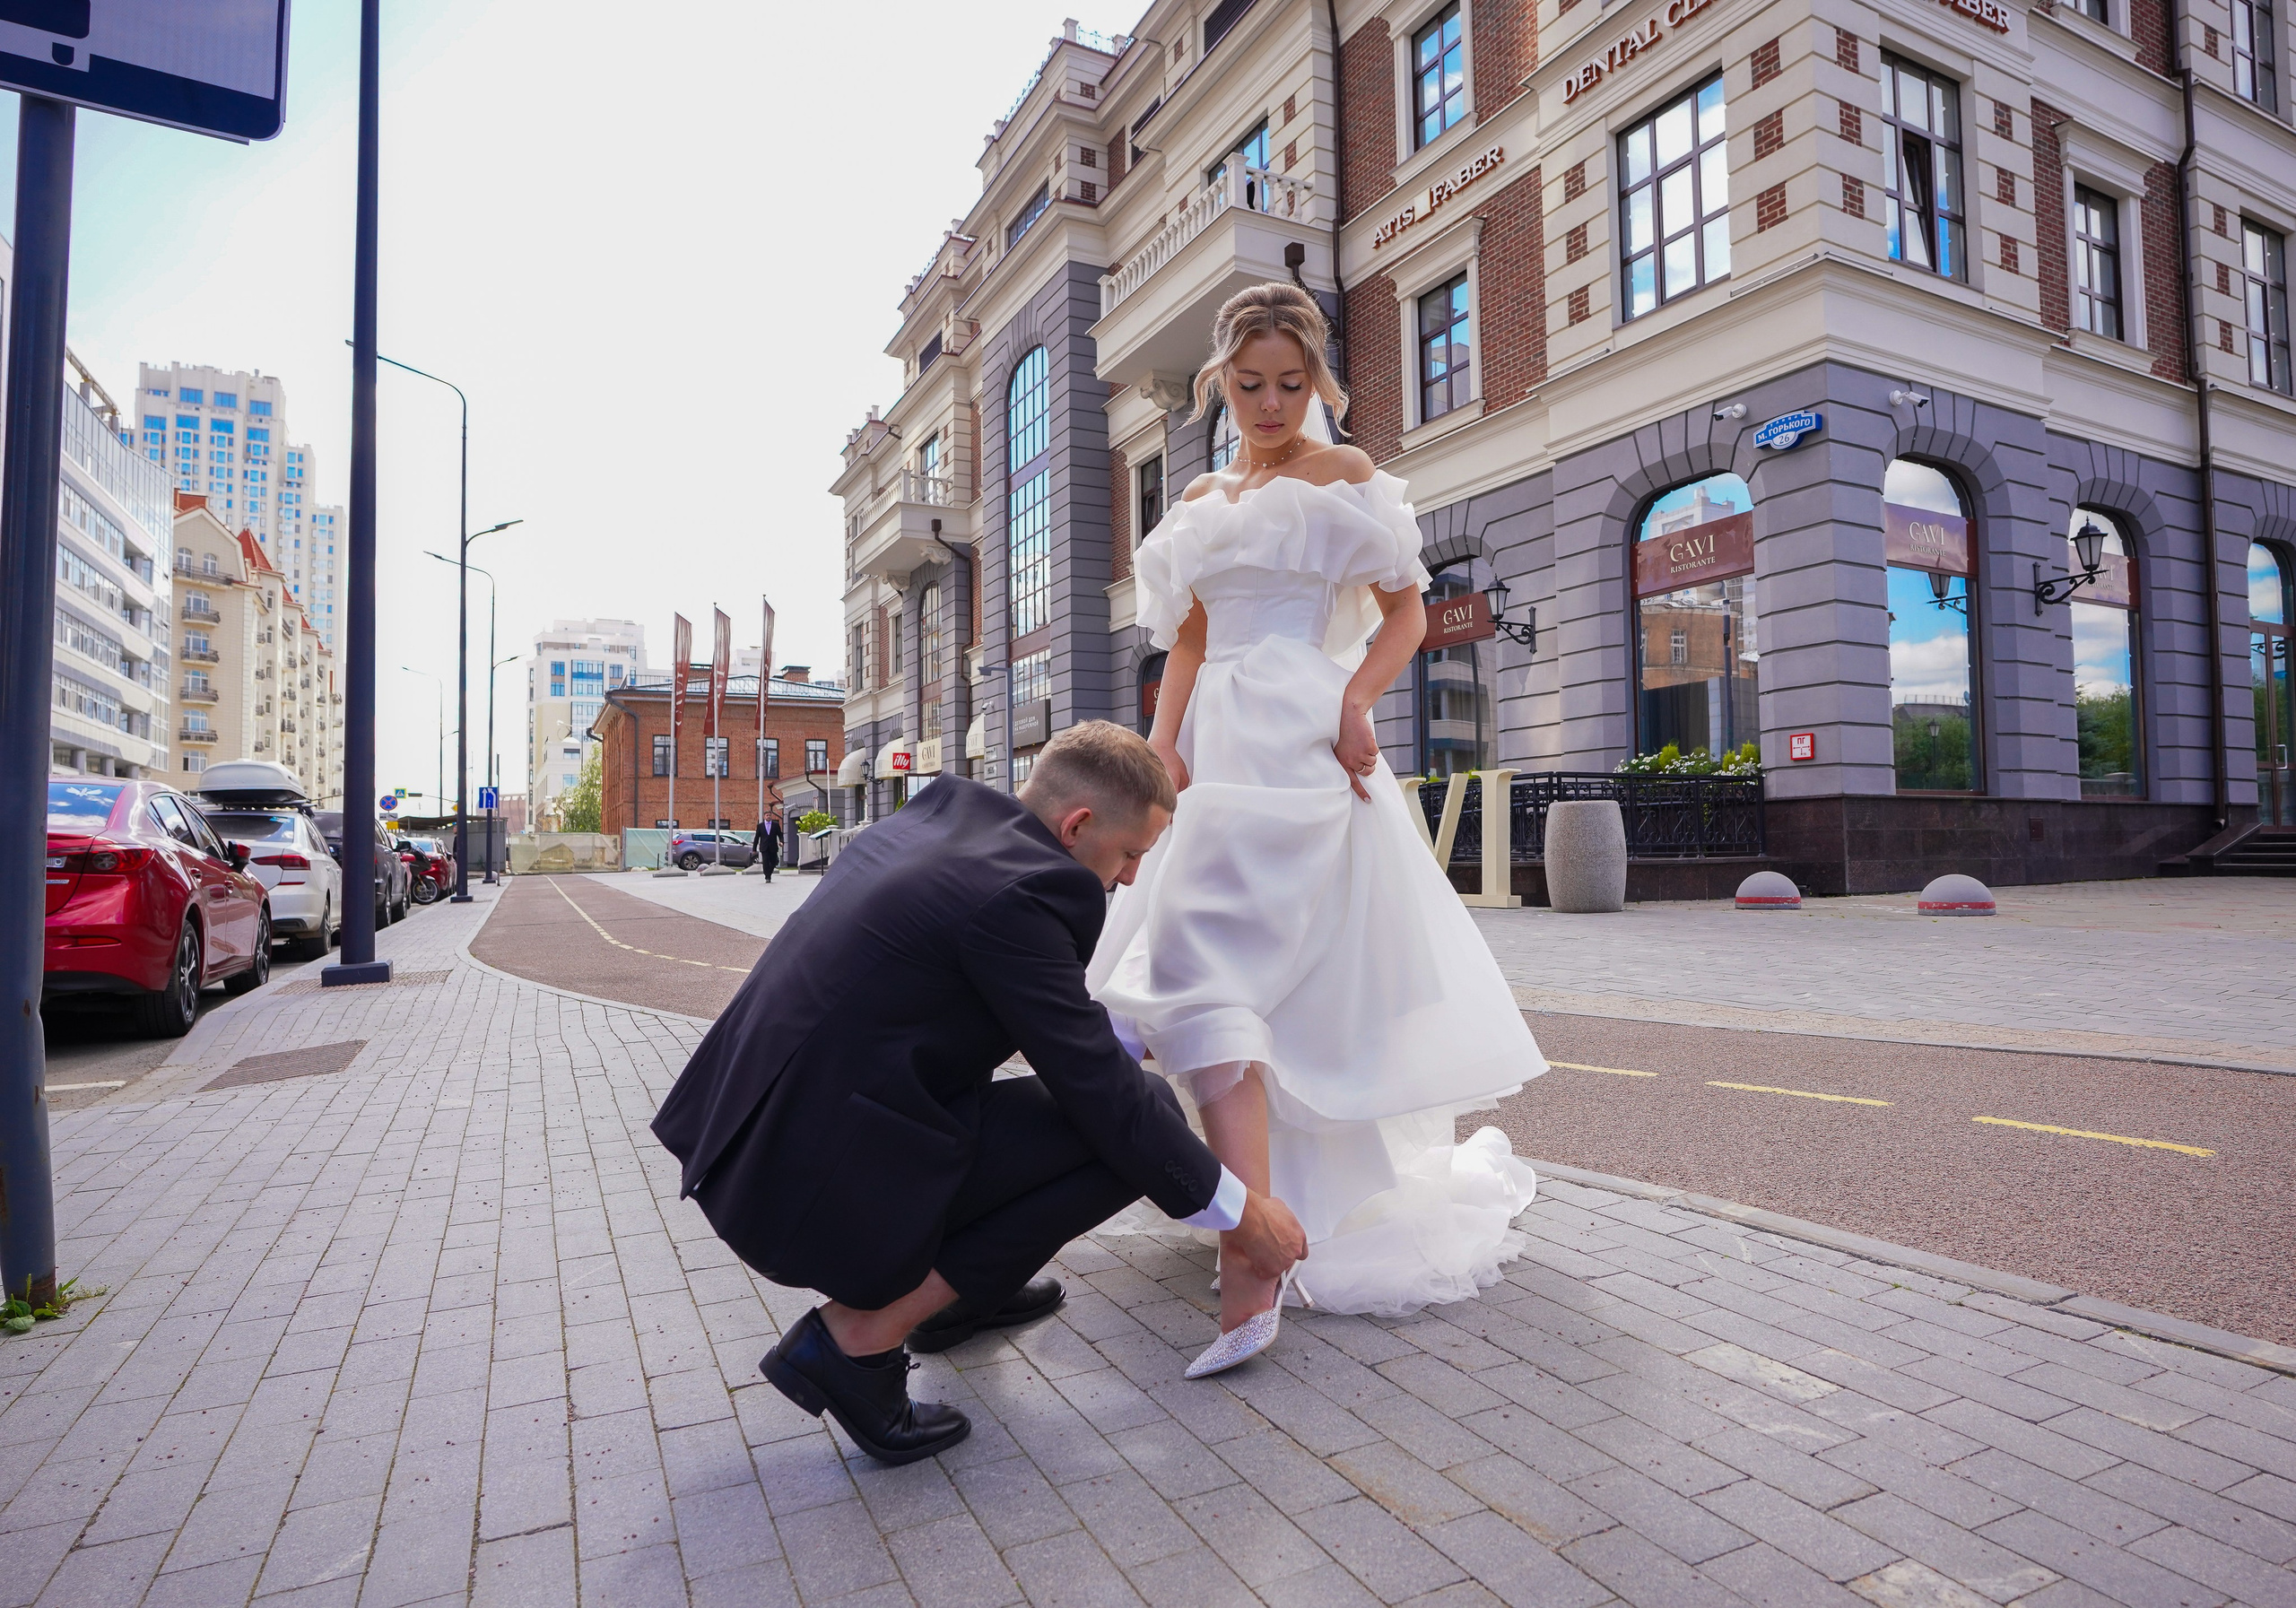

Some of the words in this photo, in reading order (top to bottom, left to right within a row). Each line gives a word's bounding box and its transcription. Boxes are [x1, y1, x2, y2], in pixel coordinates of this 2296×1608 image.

[1561, 18, 1660, 104] DENTAL
[1372, 206, 1414, 248] ATIS
[1431, 145, 1503, 207] FABER
[1758, 434, 1767, 442] М.
[1769, 418, 1811, 437] ГОРЬКОГО
[1779, 434, 1790, 444] 26
[1909, 521, 1944, 546] GAVI
[1670, 534, 1715, 562] GAVI
[1909, 543, 1946, 557] RISTORANTE
[1670, 556, 1716, 574] RISTORANTE
[1443, 604, 1473, 625] GAVI
[1443, 621, 1474, 634] RISTORANTE
[894, 754, 909, 768] illy
